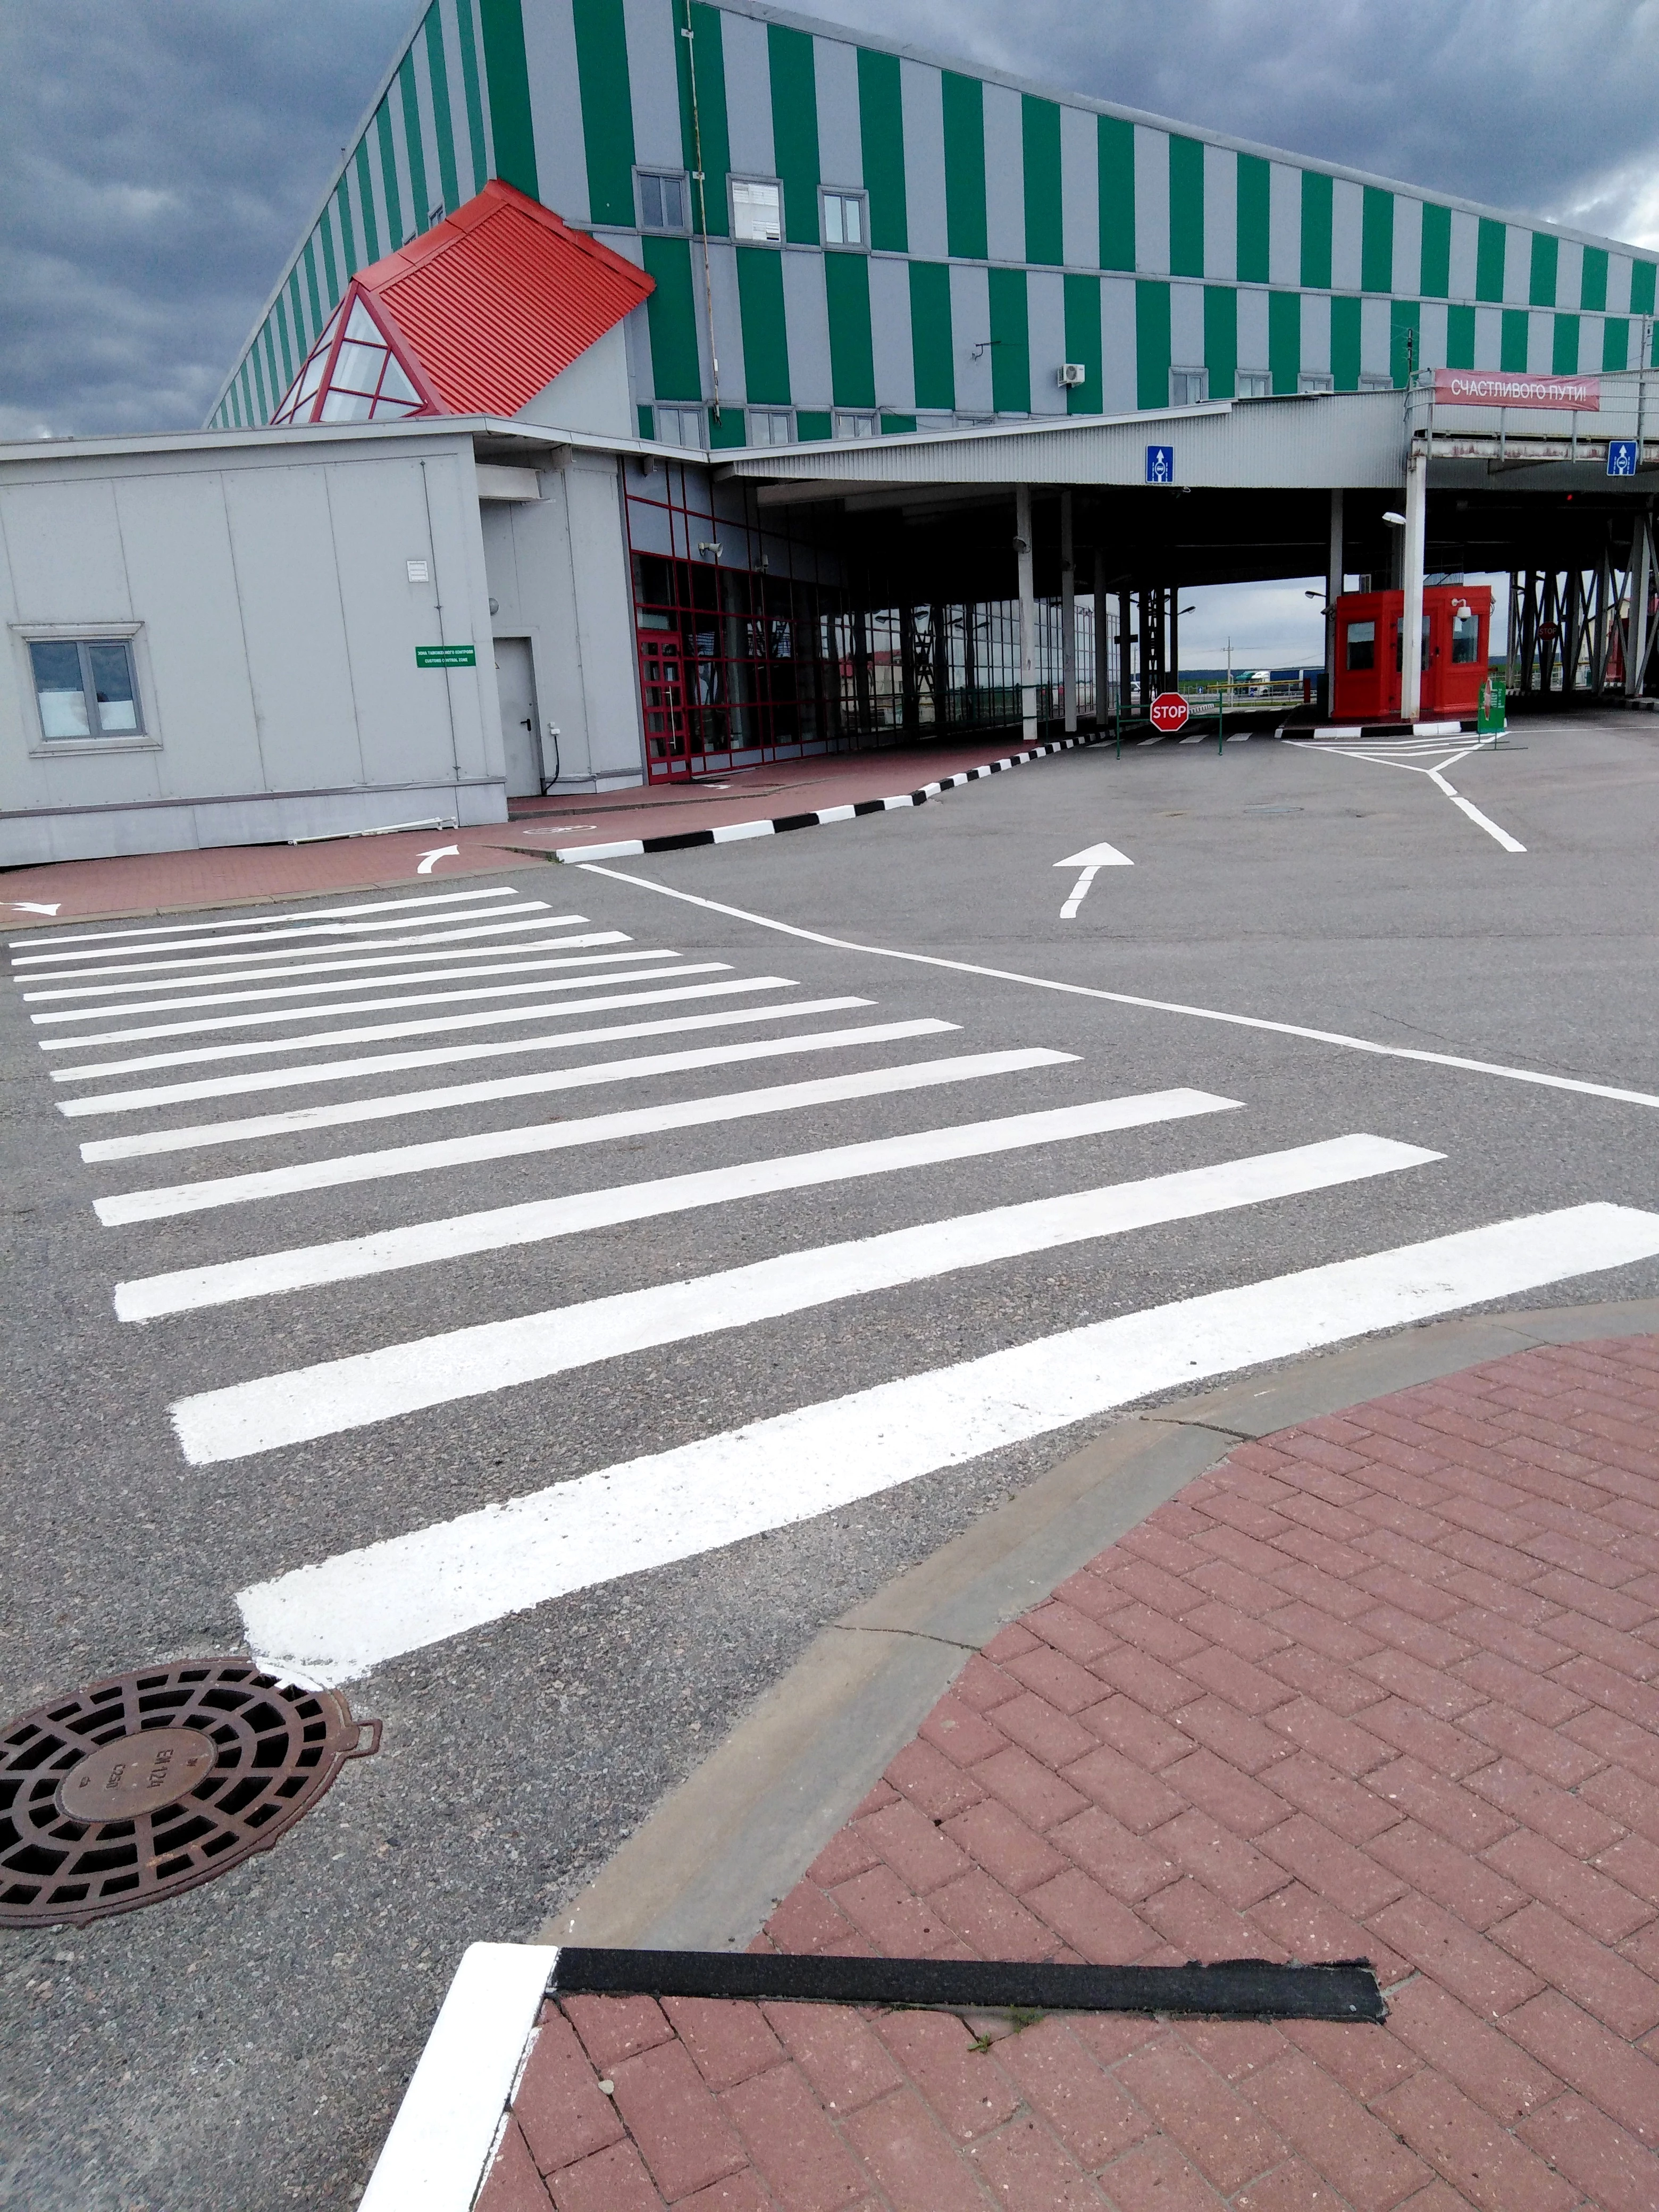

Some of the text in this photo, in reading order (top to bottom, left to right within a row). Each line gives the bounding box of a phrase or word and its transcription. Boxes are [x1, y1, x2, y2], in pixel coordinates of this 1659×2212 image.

[1451, 379, 1586, 401] СЧАСТЛИВОГО ПУТИ!
[1153, 705, 1186, 719] STOP
